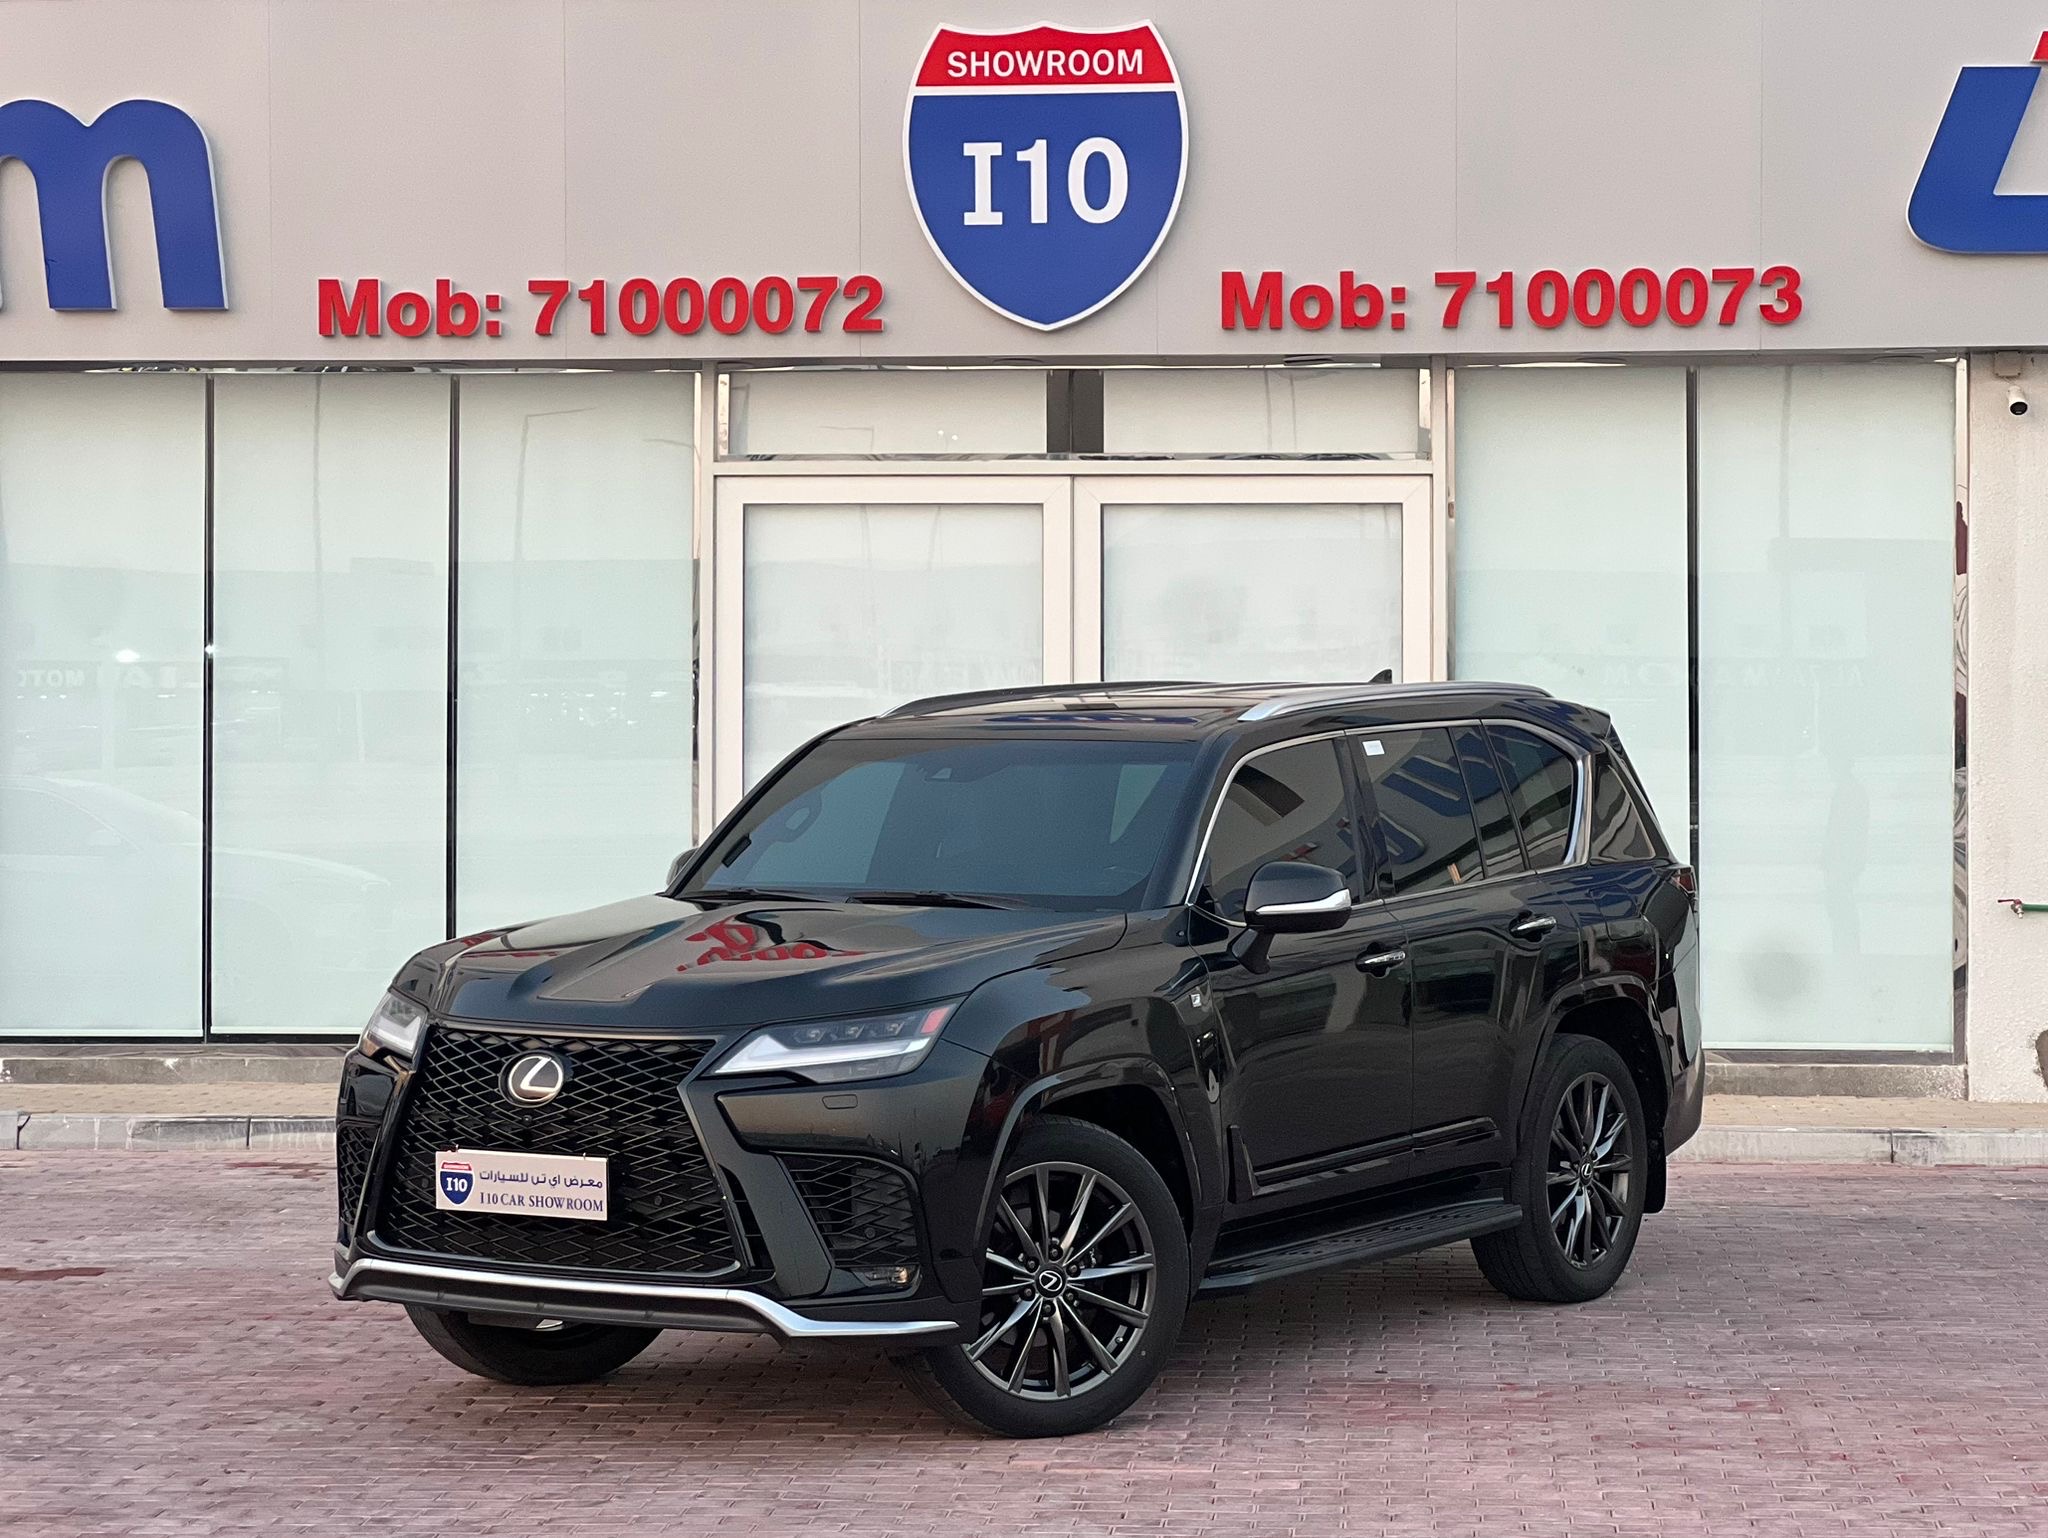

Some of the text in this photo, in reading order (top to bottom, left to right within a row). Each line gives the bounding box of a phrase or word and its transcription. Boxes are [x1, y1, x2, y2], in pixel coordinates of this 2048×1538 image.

[947, 49, 1143, 77] SHOWROOM
[963, 137, 1129, 226] I10
[318, 275, 884, 337] Mob: 71000072
[1221, 265, 1803, 330] Mob: 71000073
[446, 1177, 468, 1192] I10
[479, 1170, 528, 1183] للسيارات
[564, 1176, 603, 1188] معرض
[500, 1193, 525, 1207] CAR
[529, 1195, 603, 1211] SHOWROOM
